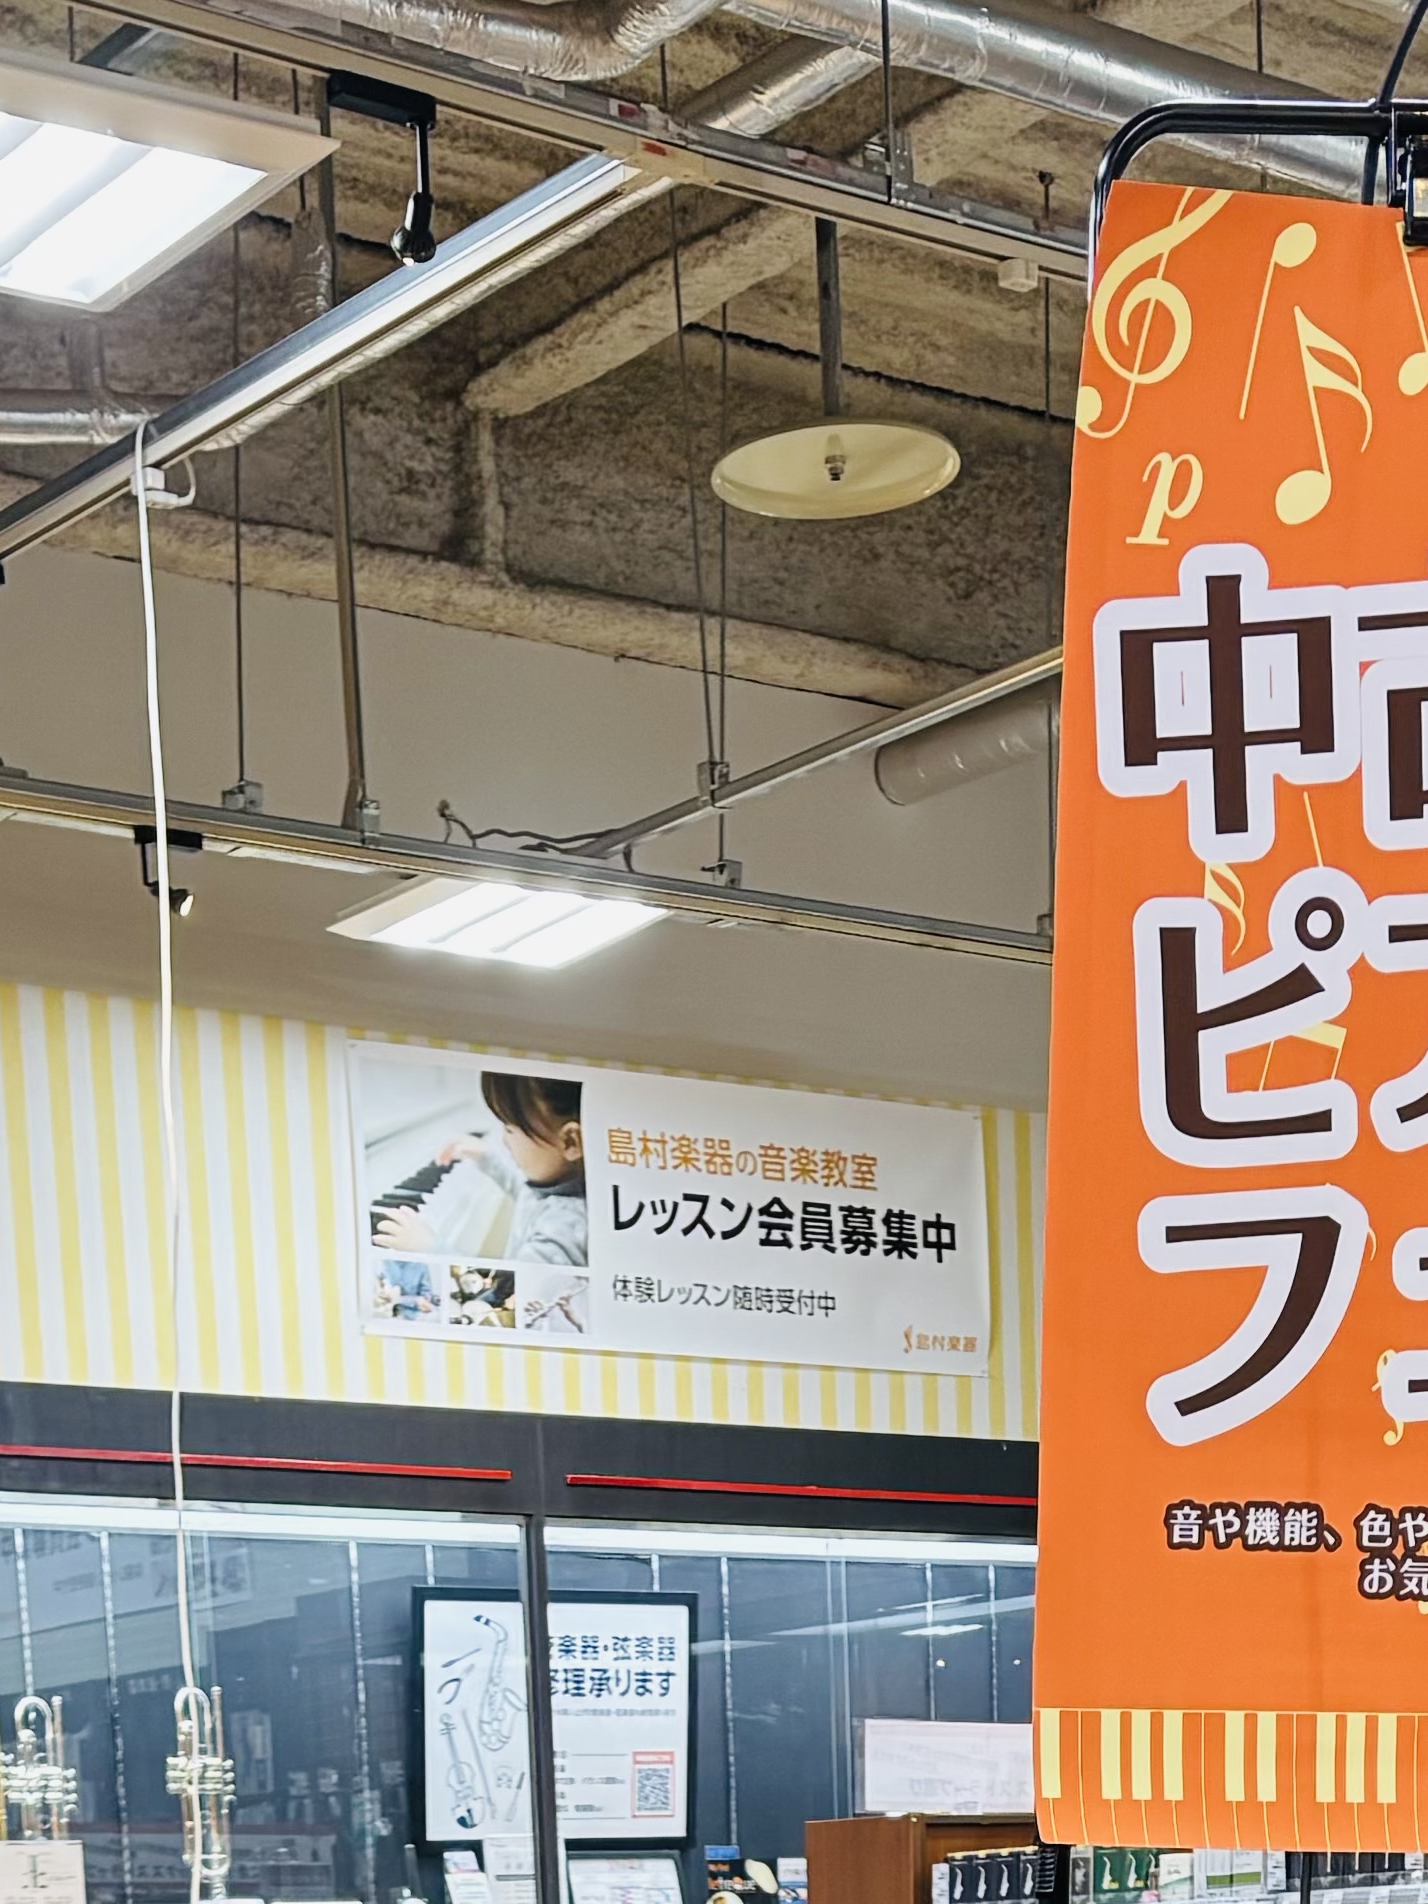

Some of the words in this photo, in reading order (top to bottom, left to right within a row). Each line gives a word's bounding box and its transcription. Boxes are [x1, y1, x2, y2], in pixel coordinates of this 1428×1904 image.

[606, 1126, 879, 1192] 島村楽器の音楽教室
[610, 1184, 957, 1263] レッスン会員募集中
[915, 1331, 978, 1353] 島村楽器
